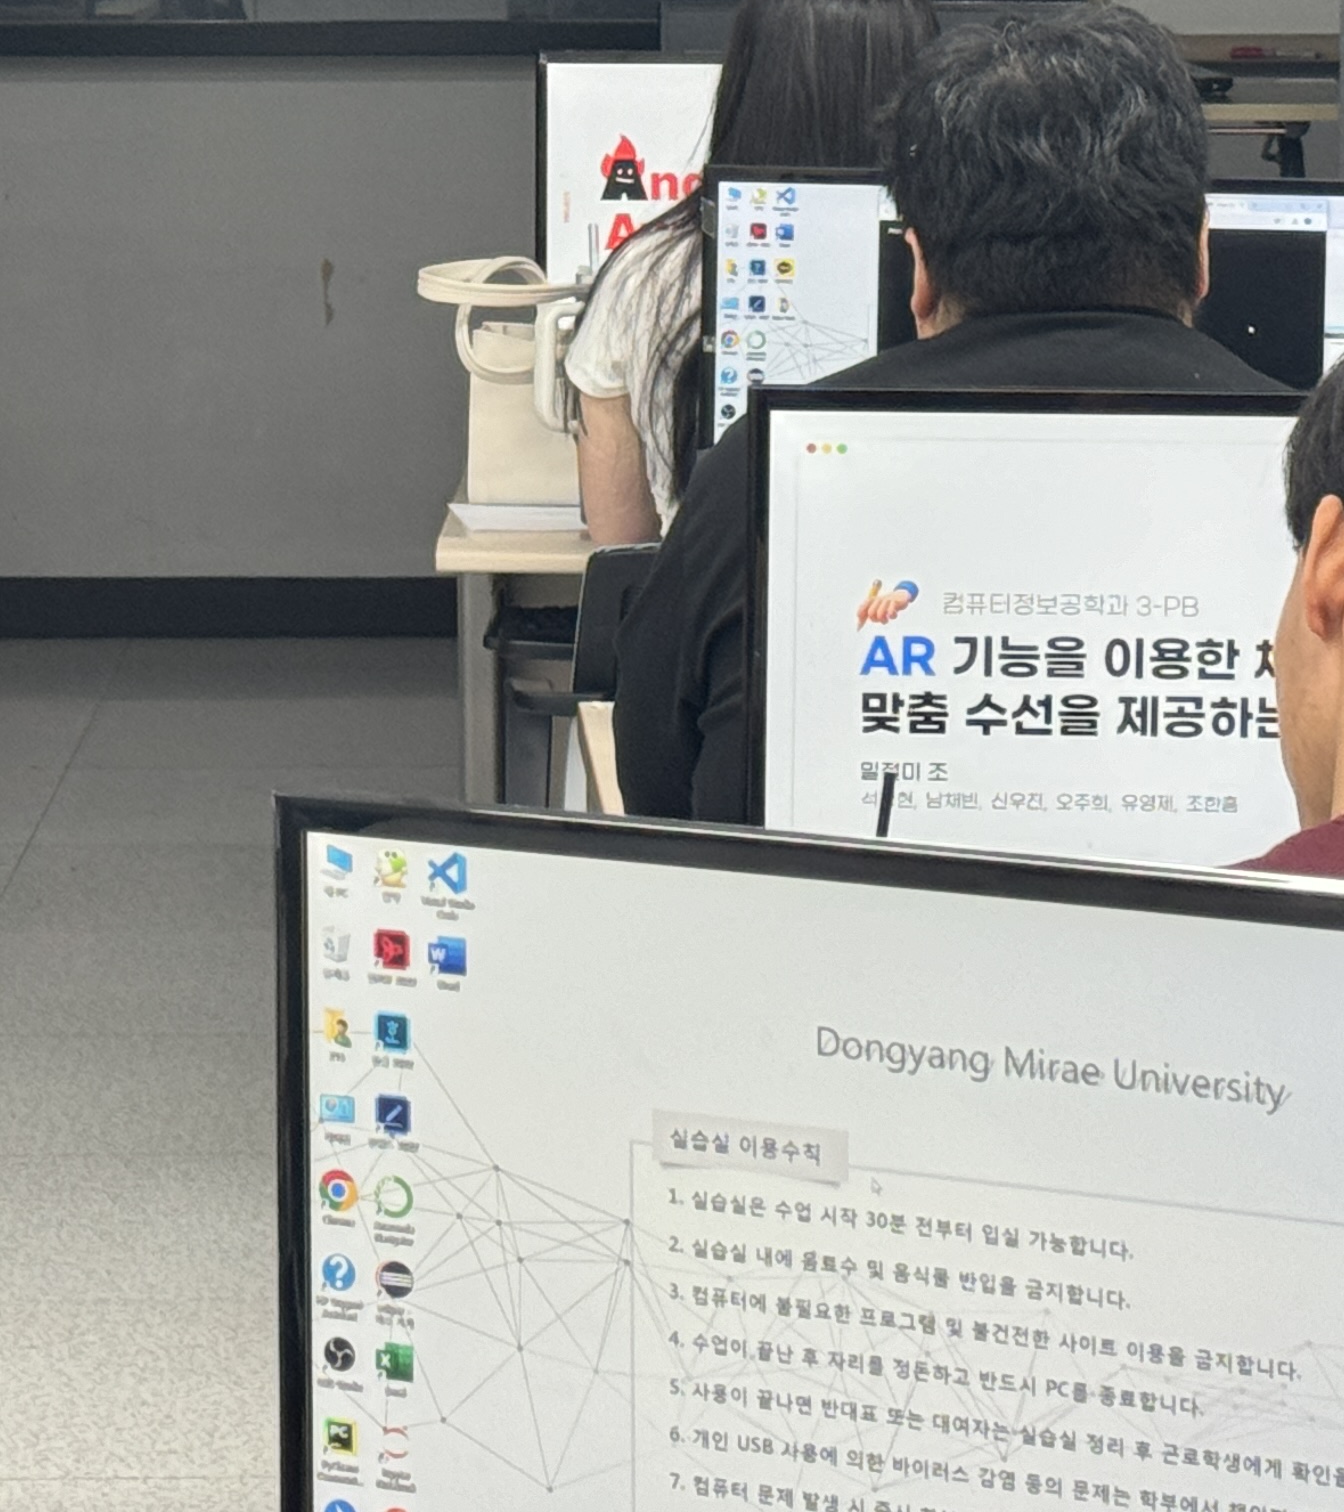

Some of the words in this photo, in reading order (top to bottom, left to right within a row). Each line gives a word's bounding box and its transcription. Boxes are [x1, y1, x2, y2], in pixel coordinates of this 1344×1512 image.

[942, 592, 1128, 617] 컴퓨터정보공학과
[1136, 595, 1200, 618] 3-PB
[860, 636, 936, 676] AR
[953, 636, 1088, 678] 기능을
[1104, 638, 1240, 680] 이용한
[860, 691, 950, 736] 맞춤
[964, 693, 1101, 737] 수선을
[1116, 694, 1281, 739] 제공하는
[860, 791, 917, 810] 석현,
[927, 762, 949, 782] 조
[816, 1025, 990, 1083] Dongyang
[1004, 1045, 1102, 1086] Mirae
[1113, 1057, 1287, 1116] University
[670, 1126, 731, 1155] 실습실
[739, 1132, 822, 1167] 이용수칙
[668, 1187, 684, 1206] 1.
[691, 1189, 767, 1218] 실습실은
[775, 1200, 812, 1224] 수업
[821, 1205, 858, 1230] 시작
[866, 1210, 907, 1236] 30분
[914, 1215, 973, 1243] 전부터
[982, 1223, 1020, 1250] 입실
[1028, 1228, 1135, 1262] 가능합니다.
[668, 1236, 685, 1254] 2.
[691, 1238, 748, 1265] 실습실
[756, 1245, 794, 1270] 내에
[866, 1258, 885, 1281] 및
[893, 1261, 951, 1290] 음식물
[958, 1269, 1017, 1297] 반입을
[1024, 1277, 1132, 1310] 금지합니다.
[668, 1282, 685, 1302] 3.
[692, 1285, 767, 1315] 컴퓨터에
[775, 1296, 852, 1326] 불필요한
[859, 1307, 937, 1335] 프로그램
[945, 1318, 963, 1339] 및
[971, 1320, 1050, 1352] 불건전한
[1058, 1331, 1118, 1358] 사이트
[1126, 1339, 1186, 1369] 이용을
[1194, 1349, 1303, 1382] 금지합니다.
[668, 1330, 685, 1349] 4.
[692, 1332, 749, 1360] 수업이
[756, 1340, 794, 1365] 끝난
[801, 1345, 820, 1368] 후
[827, 1350, 884, 1379] 자리를
[978, 1369, 1037, 1398] 반드시
[1045, 1378, 1088, 1405] PC를
[1098, 1384, 1205, 1418] 종료합니다.
[669, 1377, 686, 1397] 5.
[691, 1379, 748, 1408] 사용이
[756, 1388, 813, 1416] 끝나면
[886, 1406, 925, 1431] 또는
[932, 1412, 1010, 1444] 대여자는
[1019, 1422, 1077, 1452] 실습실
[1086, 1432, 1125, 1459] 정리
[1133, 1440, 1154, 1462] 후
[1161, 1442, 1284, 1481] 근로학생에게
[669, 1425, 686, 1445] 6.
[692, 1428, 729, 1453] 개인
[737, 1435, 775, 1456] USB
[780, 1441, 838, 1468] 사용에
[846, 1450, 885, 1474] 의한
[892, 1455, 970, 1484] 바이러스
[978, 1465, 1017, 1491] 감염
[1024, 1473, 1063, 1500] 등의
[1072, 1478, 1132, 1508] 문제는
[669, 1472, 686, 1491] 7.
[693, 1475, 749, 1503] 컴퓨터
[757, 1483, 794, 1510] 문제
[802, 1491, 840, 1512] 발생
